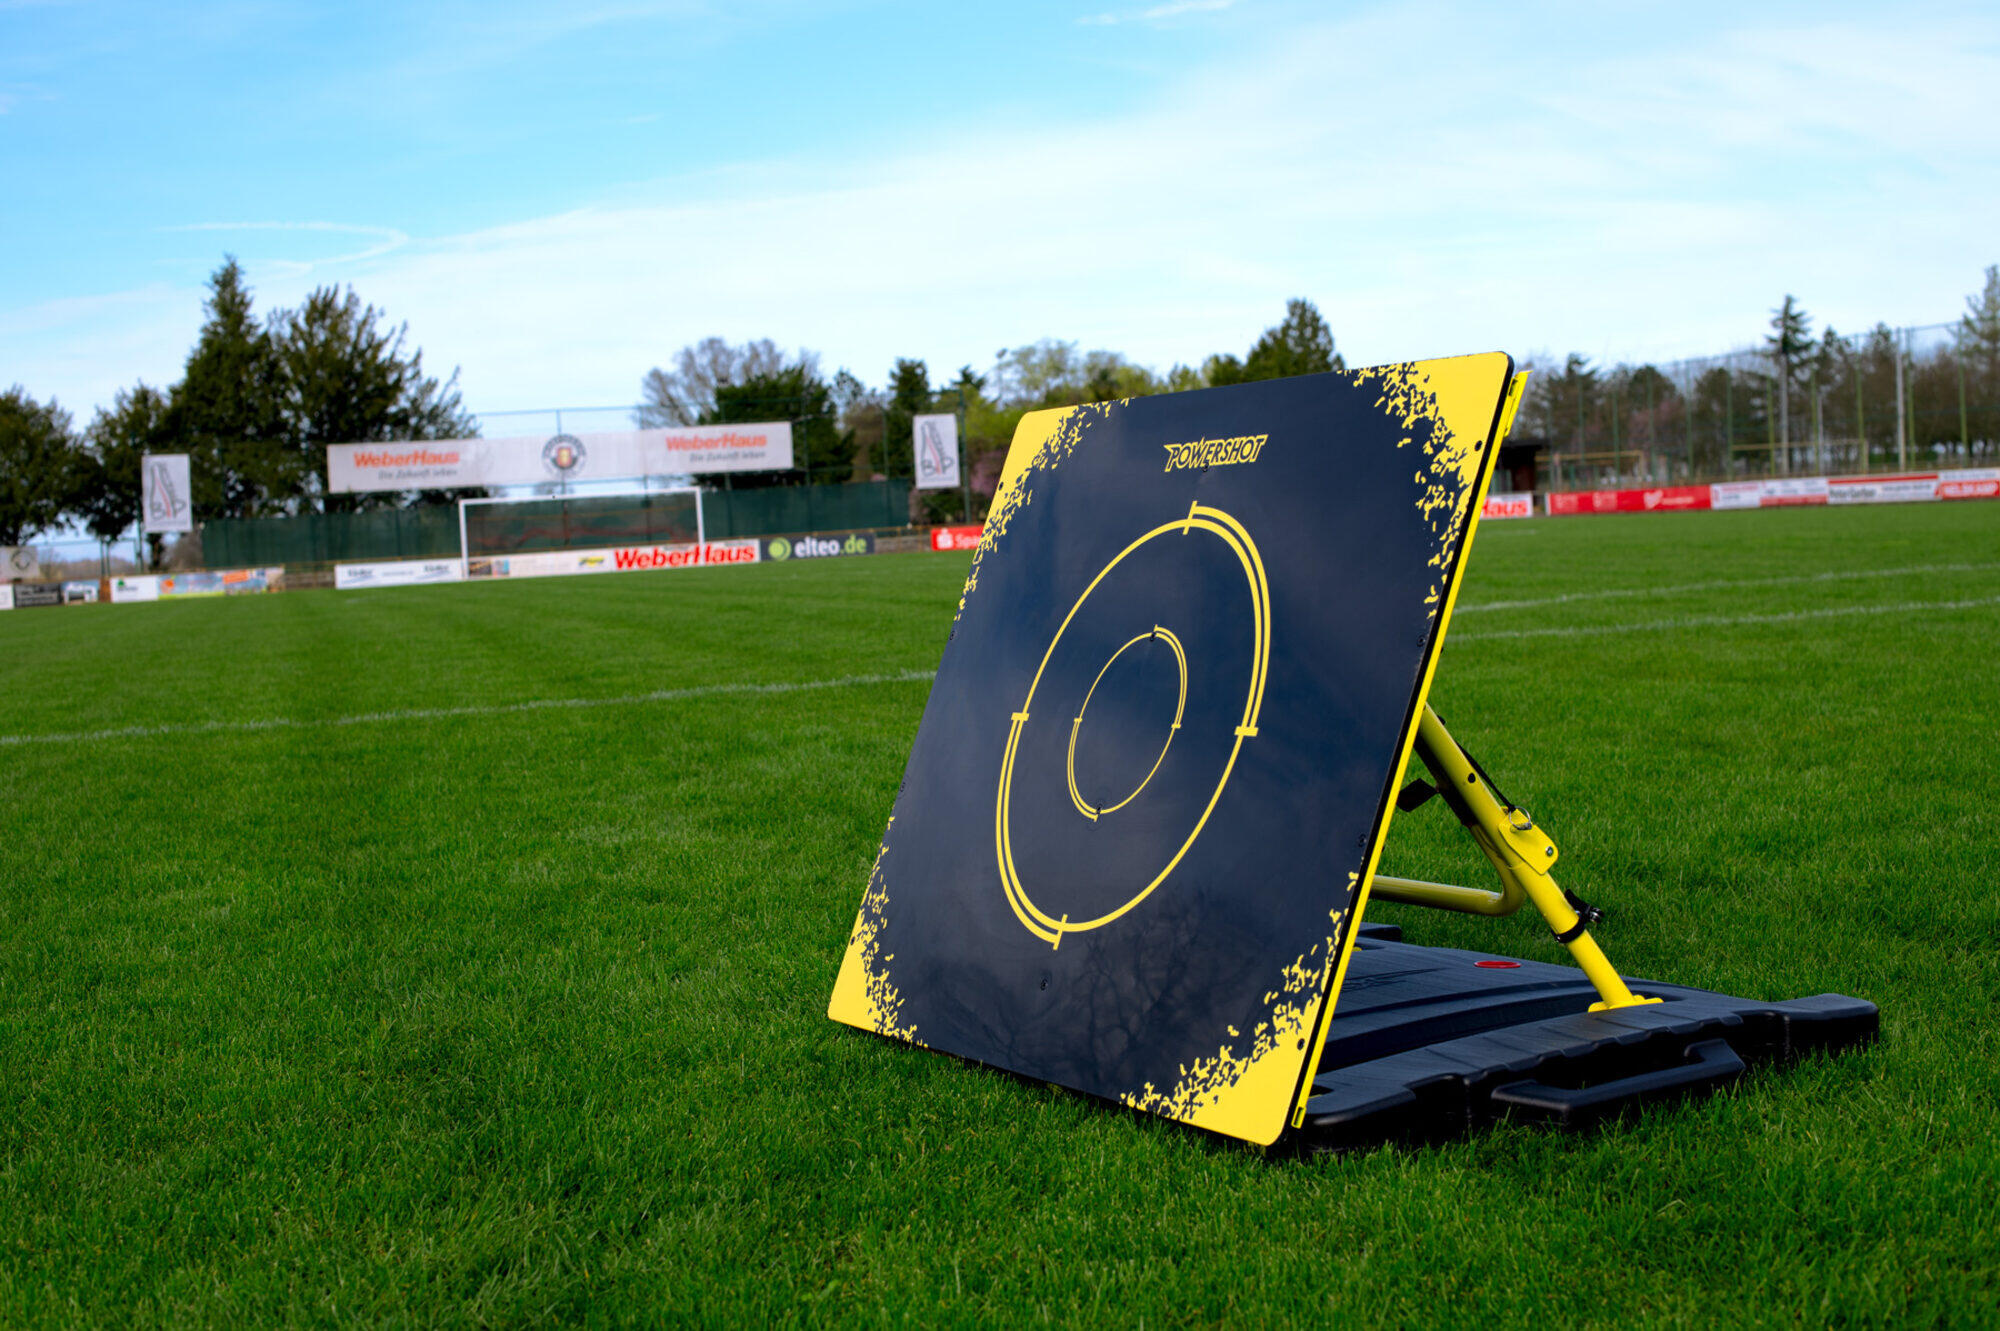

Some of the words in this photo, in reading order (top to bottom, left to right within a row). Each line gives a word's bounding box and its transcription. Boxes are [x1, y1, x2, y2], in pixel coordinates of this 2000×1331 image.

[665, 433, 768, 453] WeberHaus
[1163, 434, 1269, 472] POWERSHOT
[353, 450, 460, 468] WeberHaus
[613, 543, 756, 570] WeberHaus
[794, 534, 867, 558] elteo.de
